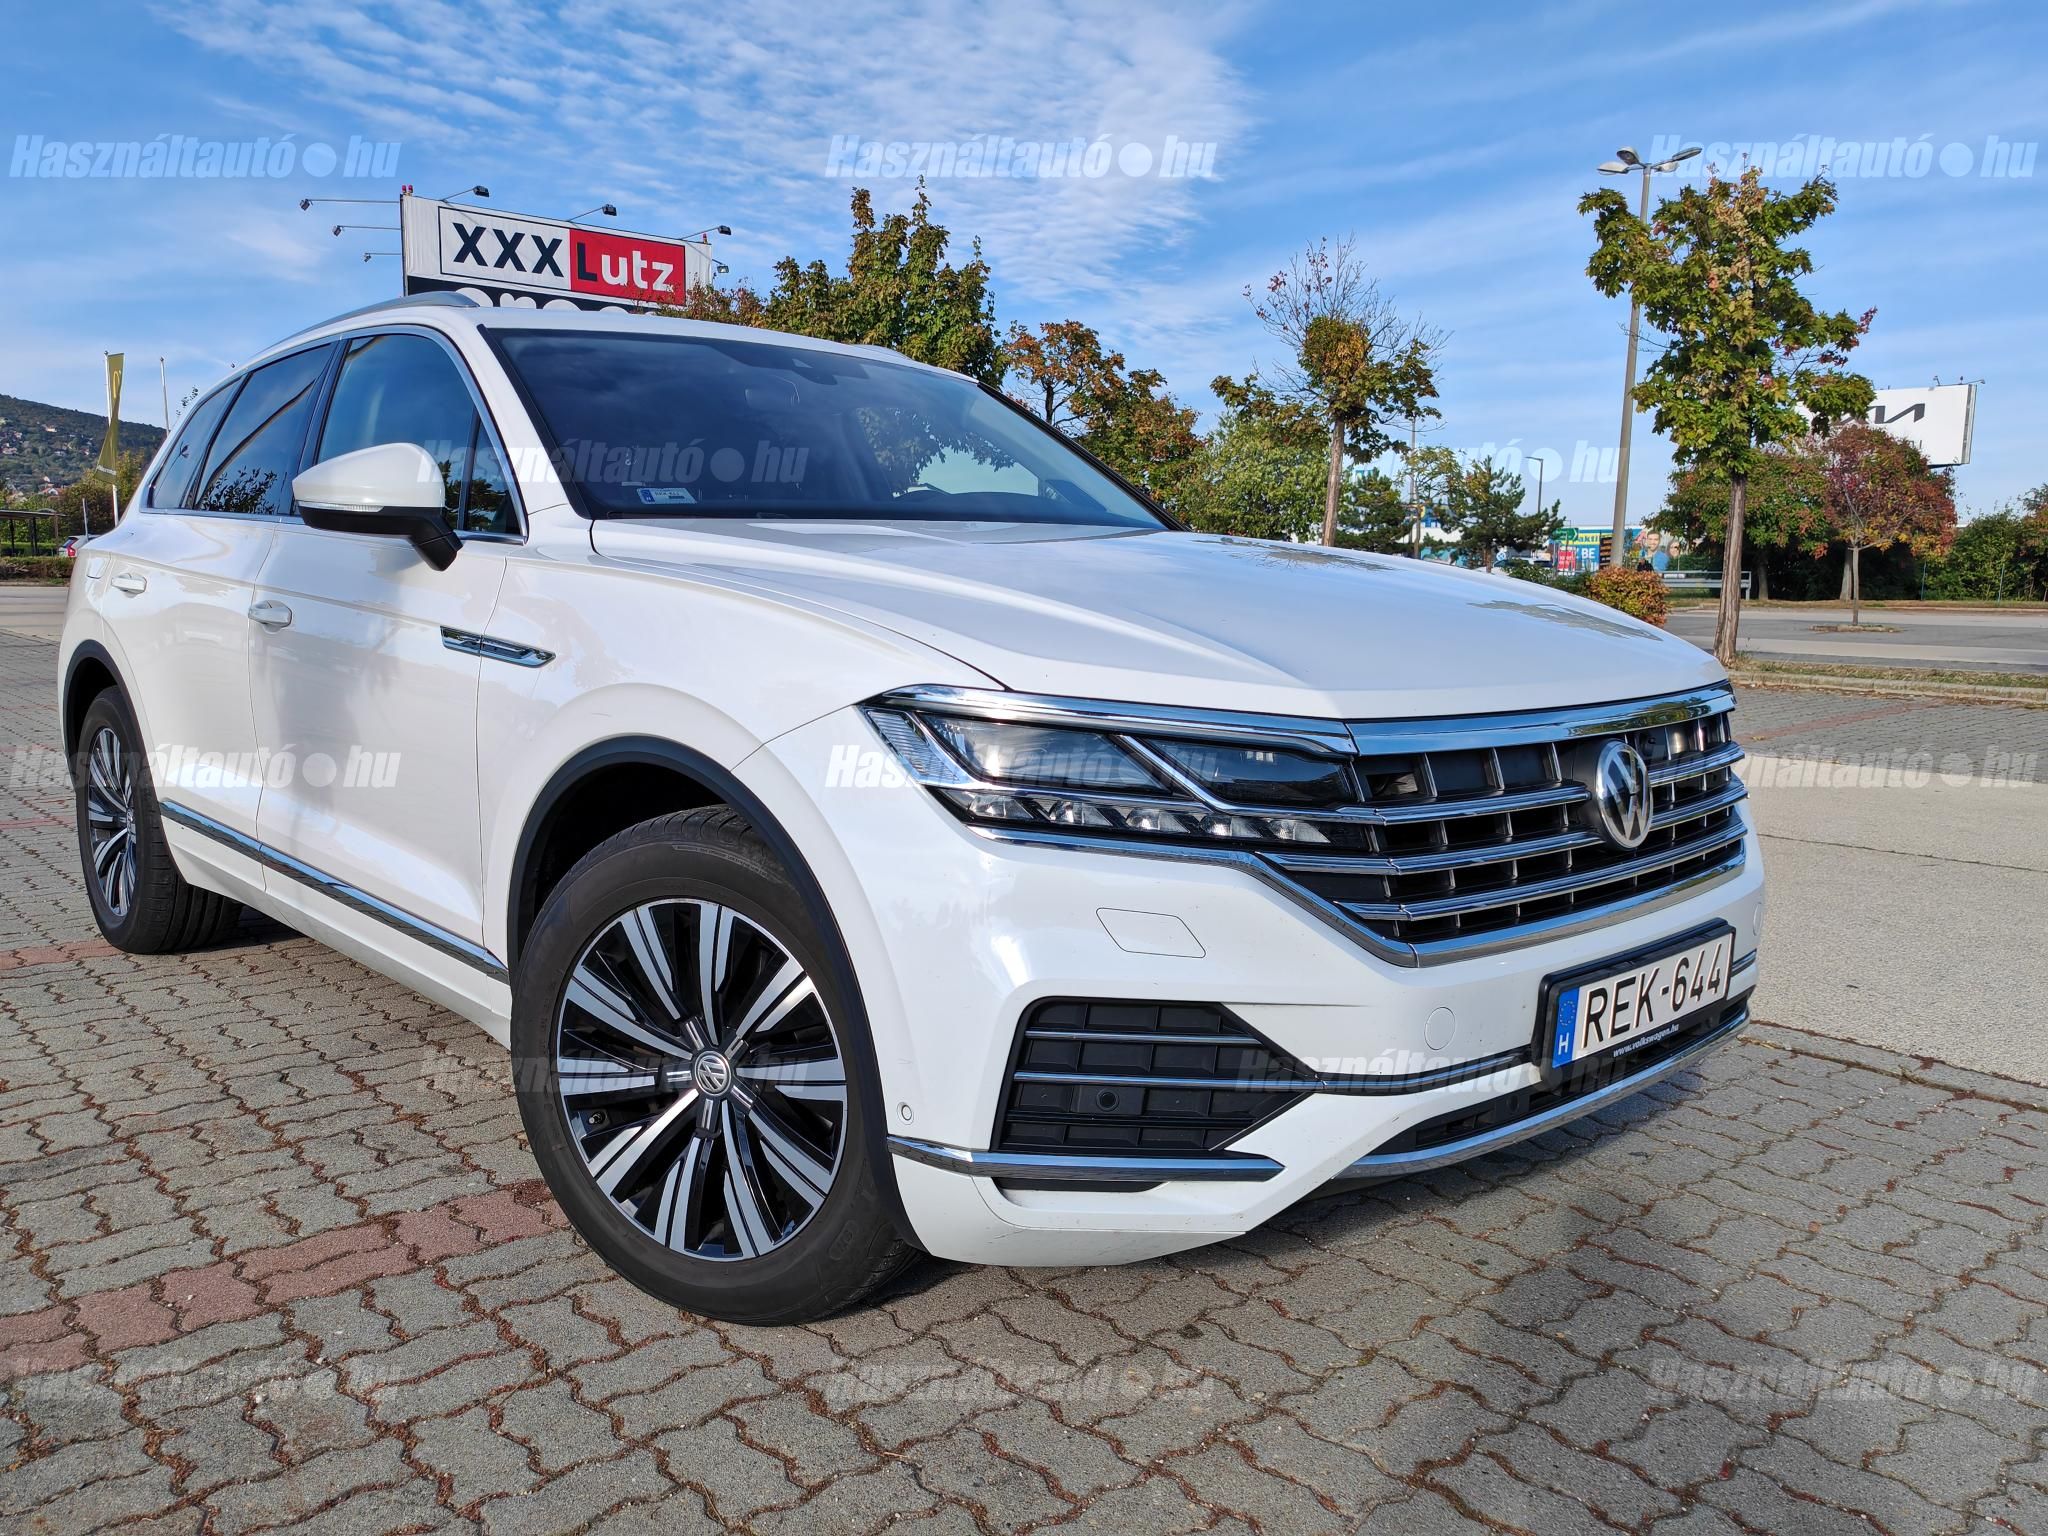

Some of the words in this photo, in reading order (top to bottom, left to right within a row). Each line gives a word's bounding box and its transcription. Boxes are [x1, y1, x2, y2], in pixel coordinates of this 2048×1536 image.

[452, 222, 674, 293] XXXLutz
[1581, 943, 1722, 1049] REK-644
[1558, 1033, 1570, 1055] H
[1613, 1023, 1679, 1057] www.volkswagen.hu
